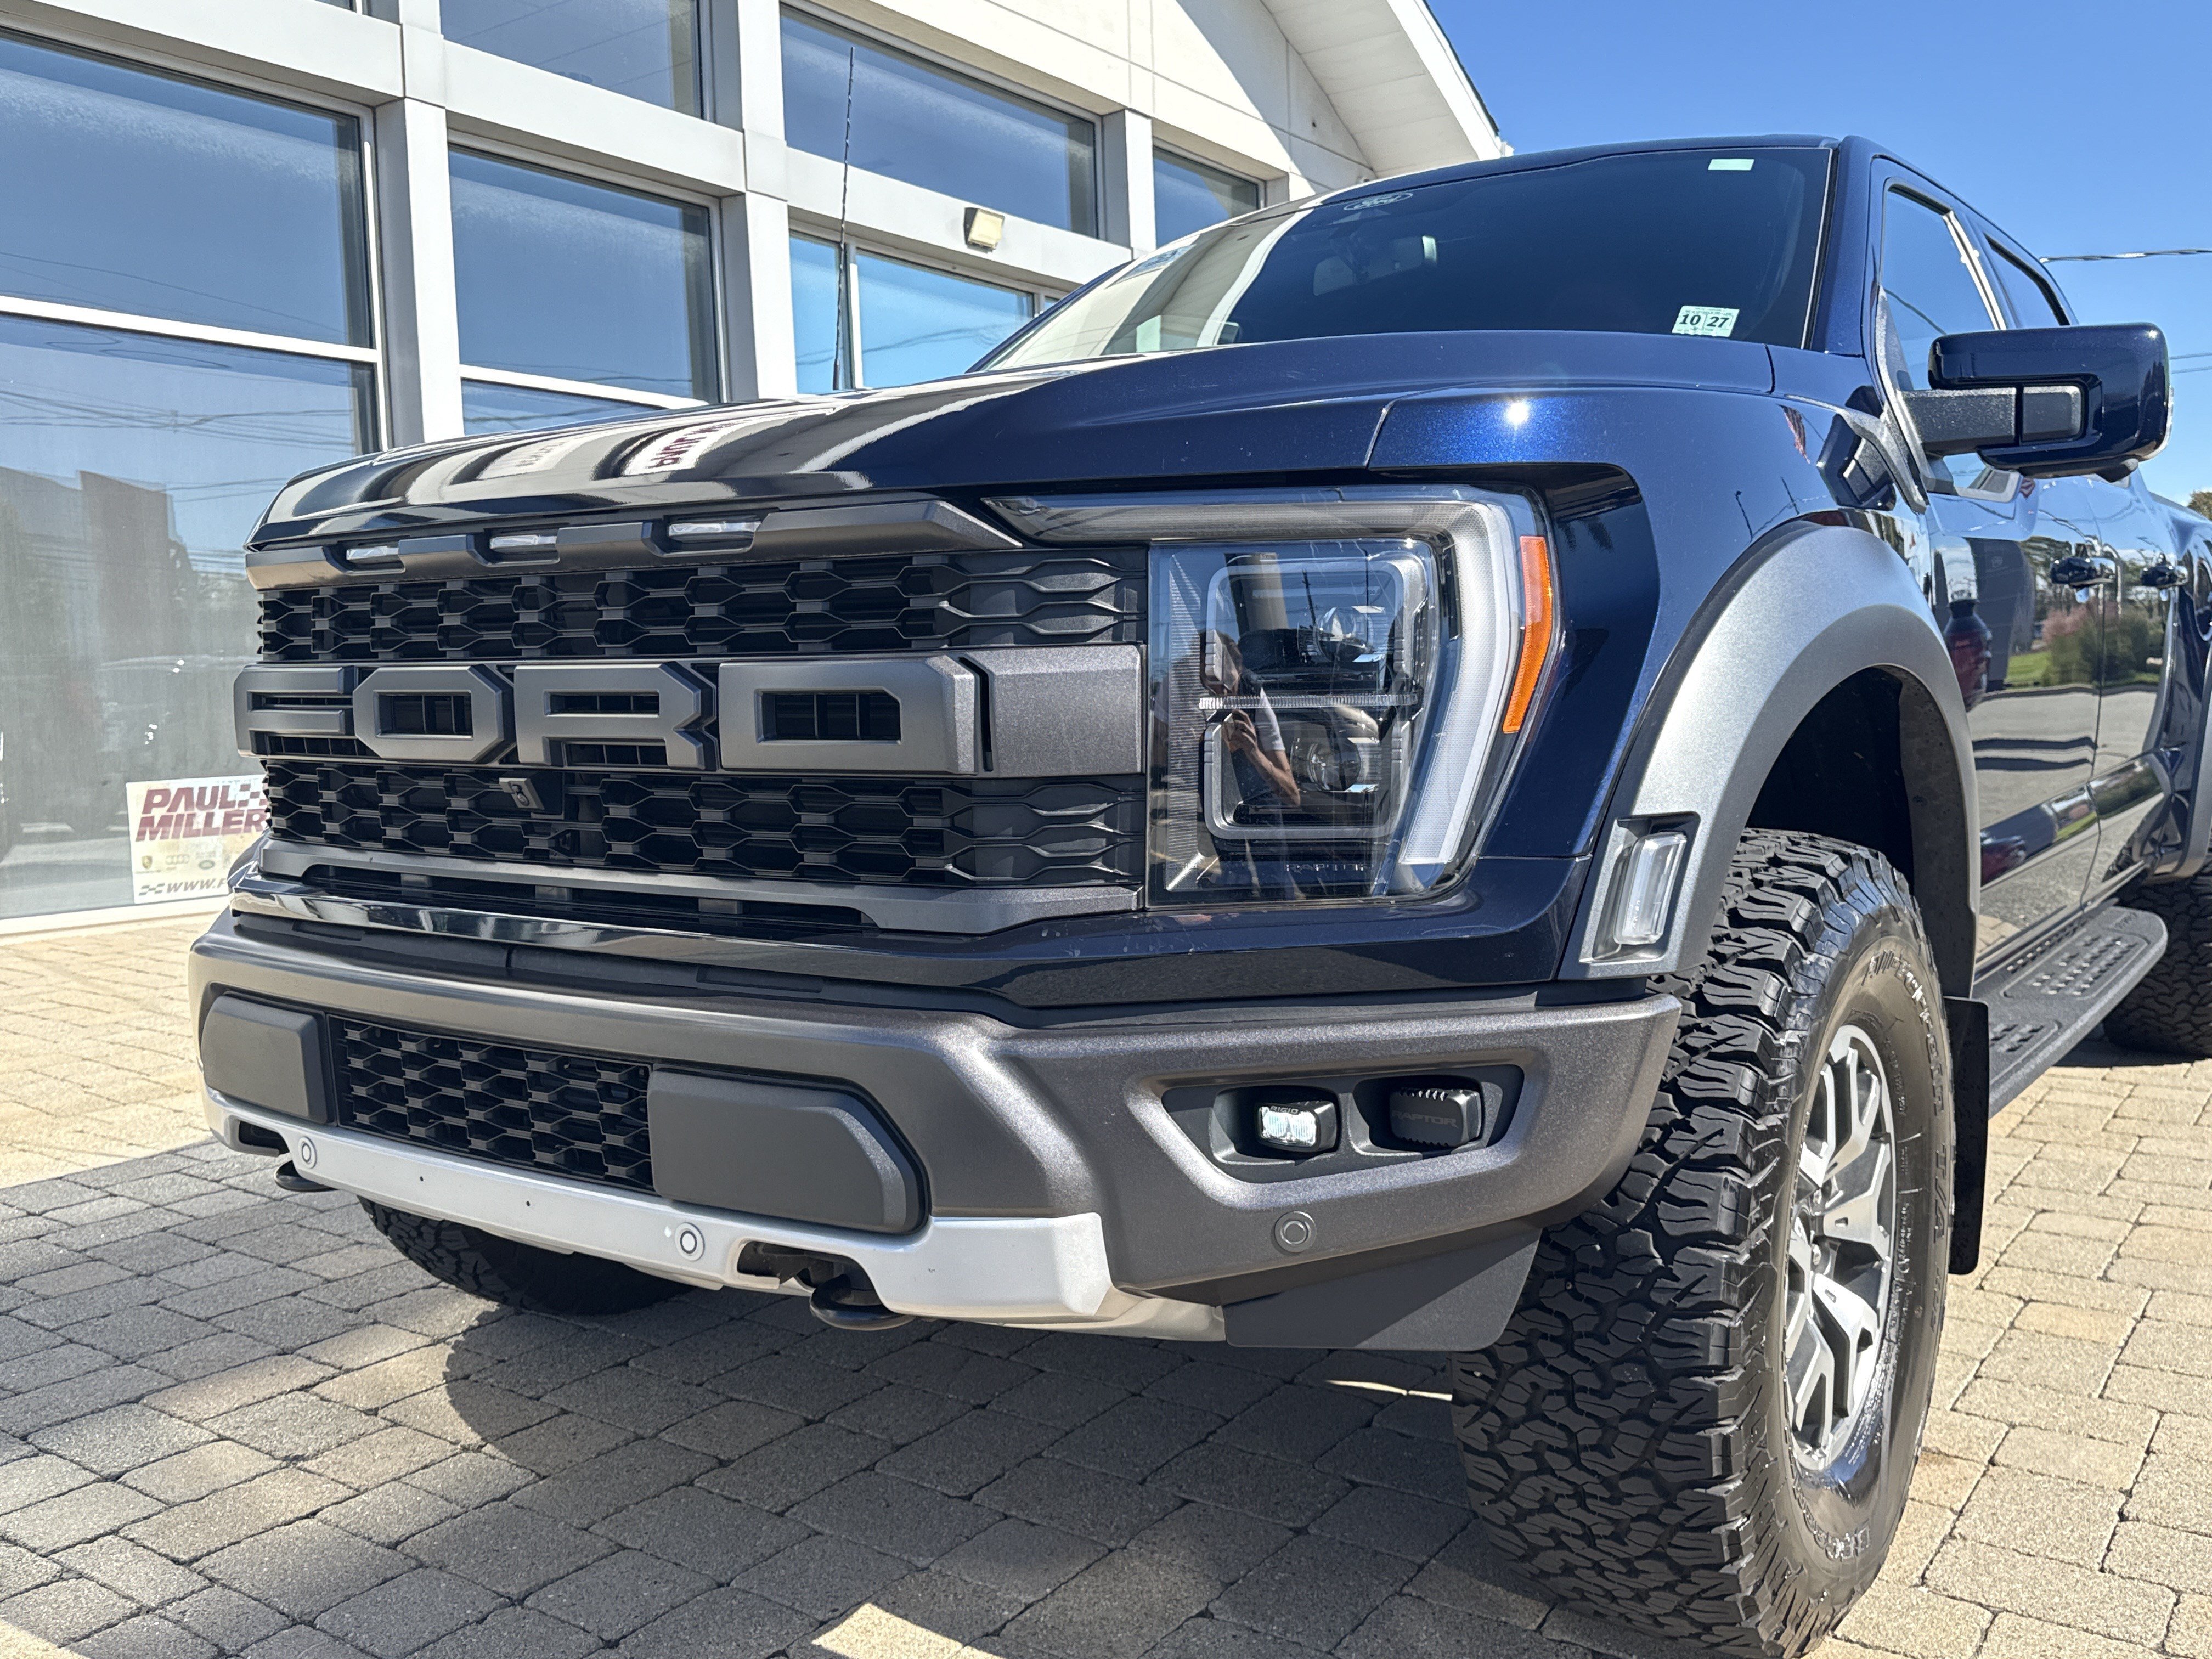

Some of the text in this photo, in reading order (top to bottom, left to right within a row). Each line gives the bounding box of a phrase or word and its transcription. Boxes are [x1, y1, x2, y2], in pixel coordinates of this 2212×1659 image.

[1679, 314, 1730, 328] 10 27
[235, 653, 979, 777] FORD
[142, 784, 236, 815] PAUL
[136, 809, 267, 842] MILLER
[1269, 1105, 1299, 1115] RIGID
[1391, 1110, 1460, 1129] RAPTOR
